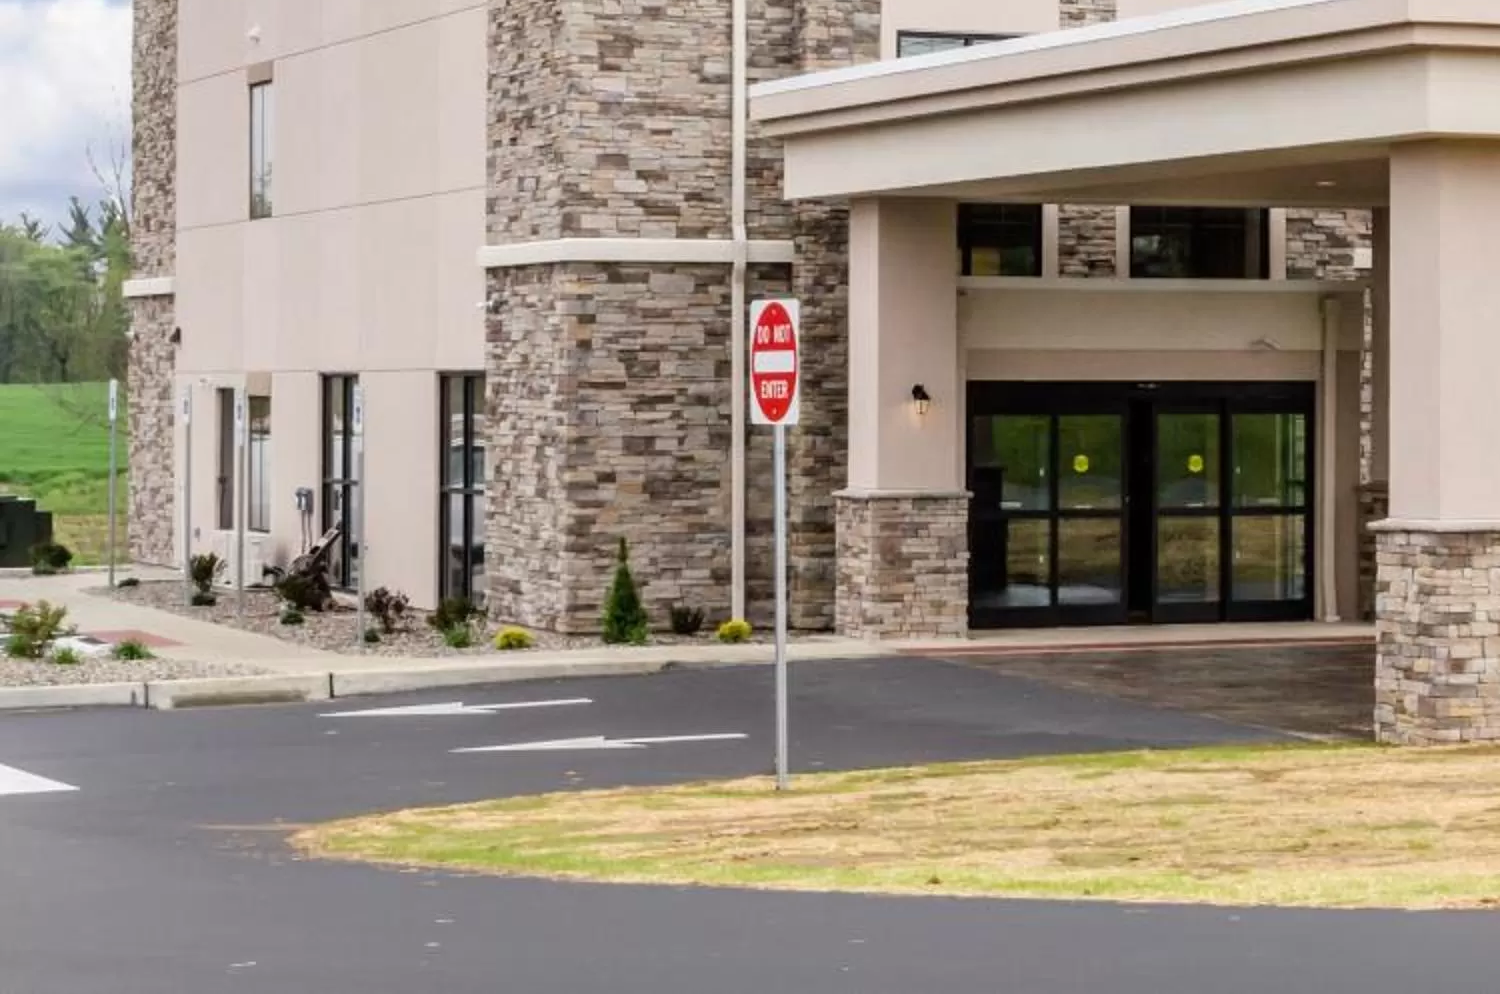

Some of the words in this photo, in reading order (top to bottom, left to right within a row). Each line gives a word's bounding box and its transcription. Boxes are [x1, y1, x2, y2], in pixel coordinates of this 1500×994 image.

[757, 325, 770, 344] DO
[773, 324, 791, 343] NOT
[761, 380, 789, 399] ENTER
